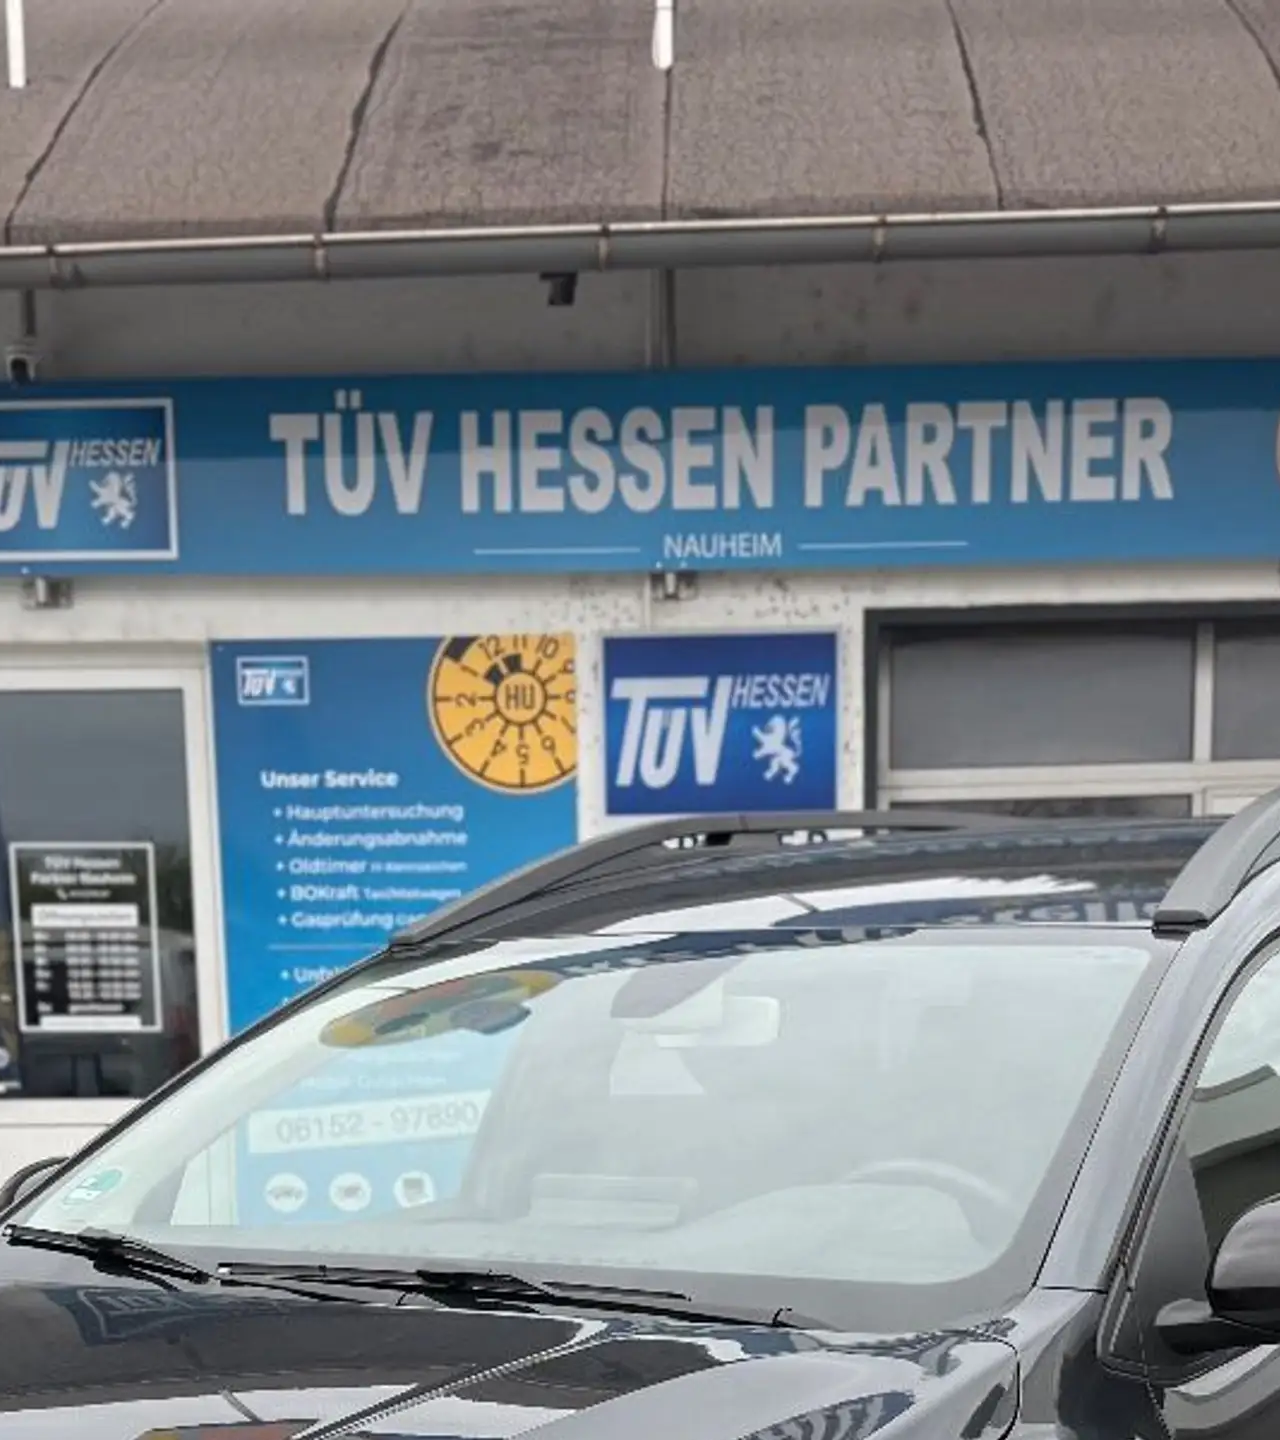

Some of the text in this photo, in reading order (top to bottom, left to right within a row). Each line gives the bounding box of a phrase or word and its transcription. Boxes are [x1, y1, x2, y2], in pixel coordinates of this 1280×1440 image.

[69, 437, 162, 467] HESSEN
[269, 389, 1174, 515] TÜV HESSEN PARTNER
[663, 532, 783, 559] NAUHEIM
[505, 684, 536, 711] HU
[730, 672, 832, 709] HESSEN
[260, 768, 400, 789] Unser Service
[286, 802, 465, 823] Hauptuntersuchung
[287, 827, 469, 851] Änderungsabnahme
[288, 857, 368, 876] Oldtimer
[290, 883, 359, 902] BOKraft
[291, 910, 395, 930] Gasprüfung
